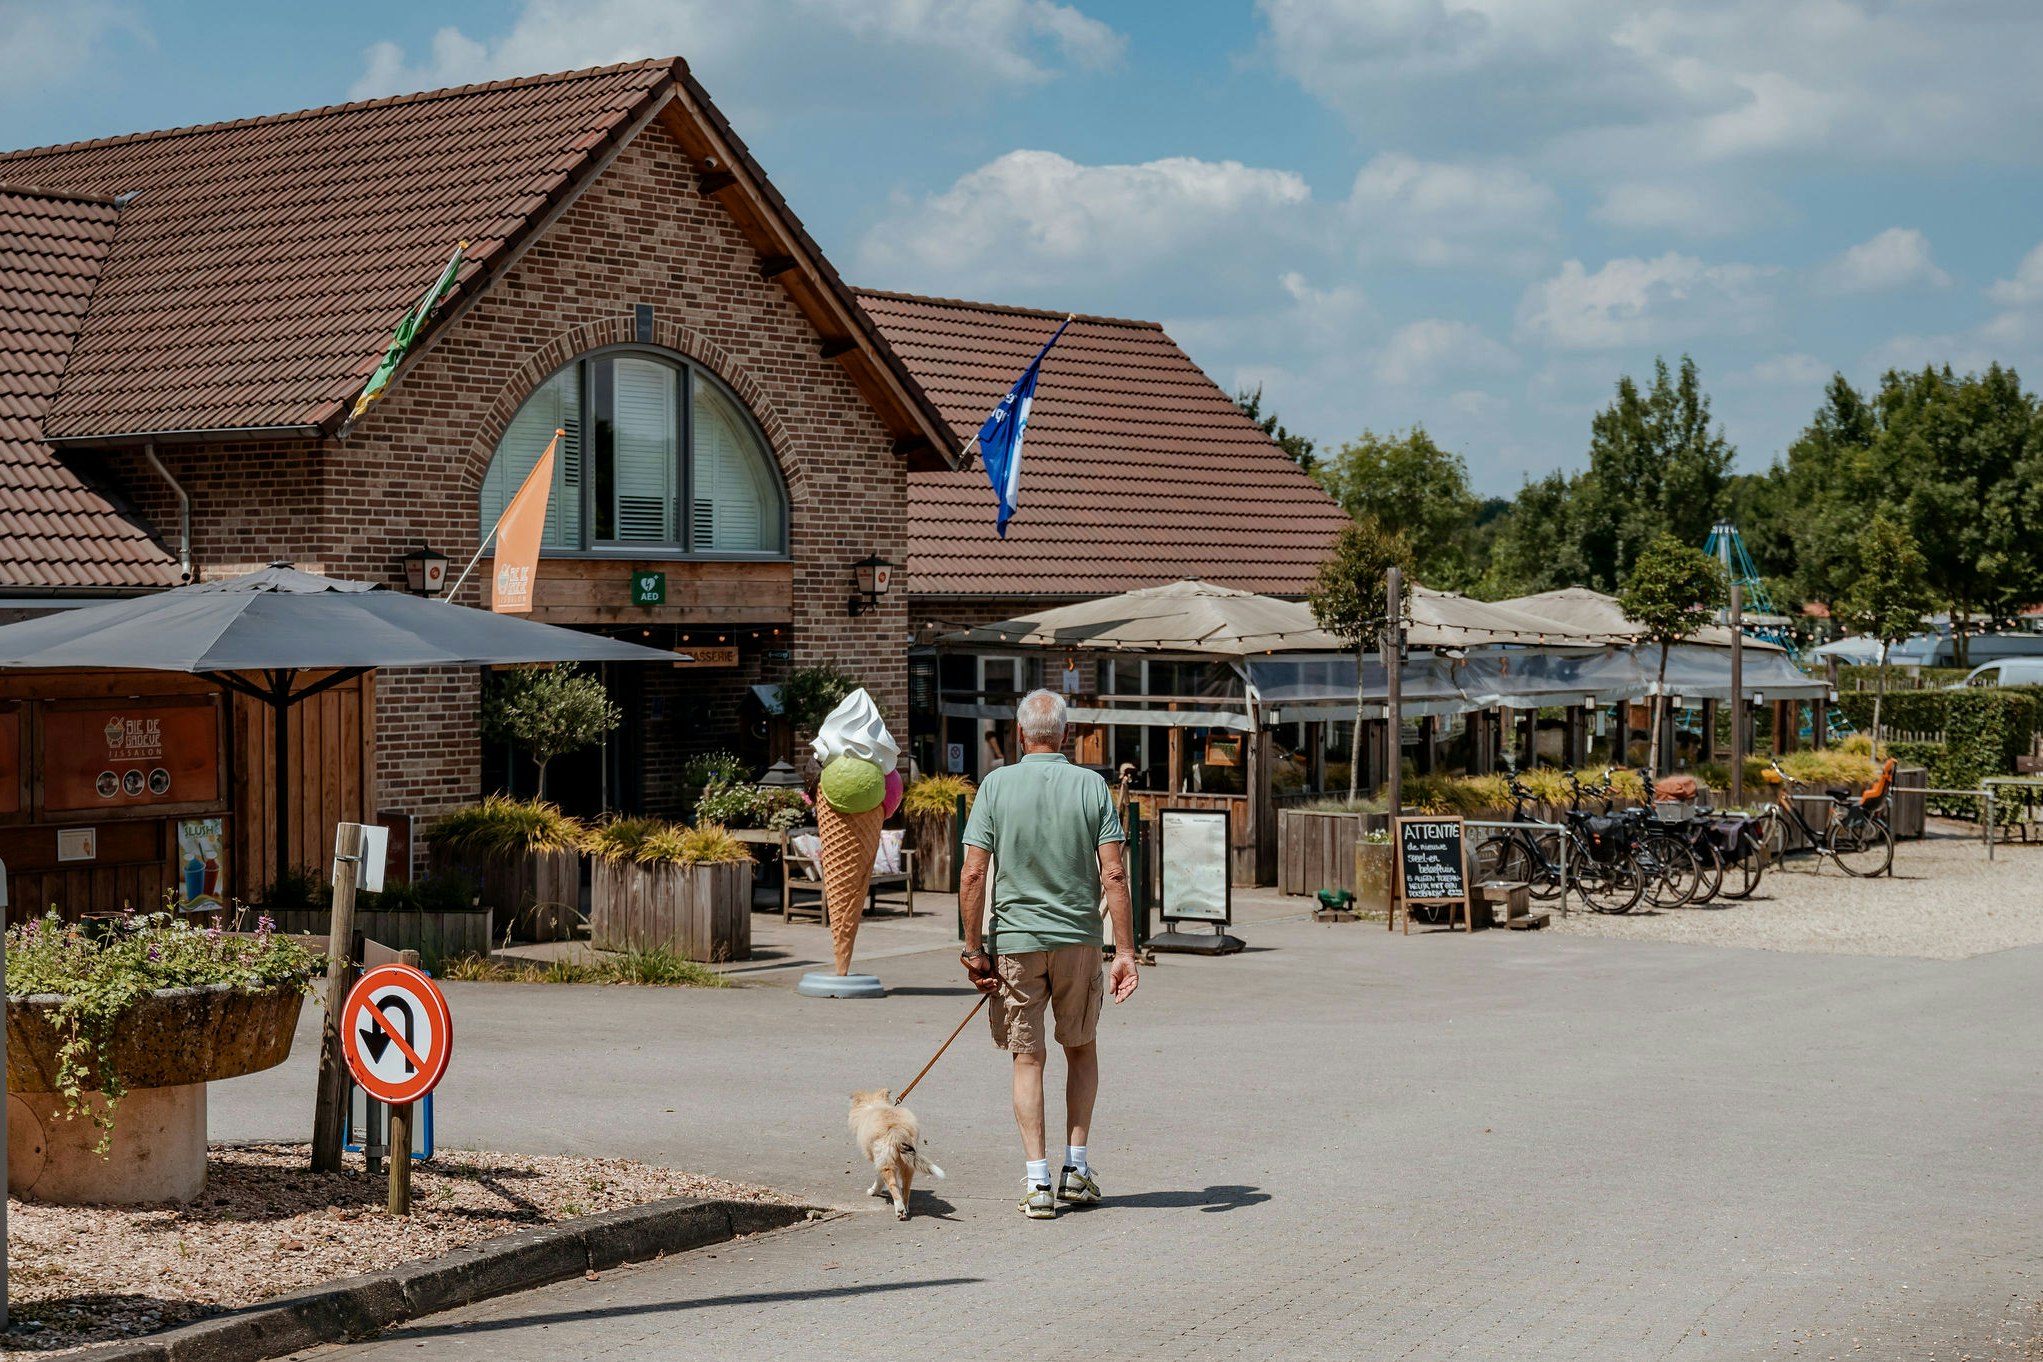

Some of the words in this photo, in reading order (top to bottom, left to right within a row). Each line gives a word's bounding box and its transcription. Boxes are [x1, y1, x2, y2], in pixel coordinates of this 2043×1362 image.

[640, 592, 659, 601] AED
[146, 719, 161, 733] DE
[184, 825, 214, 837] SLUSH
[1404, 823, 1460, 840] ATTENTIE
[1407, 842, 1419, 851] de
